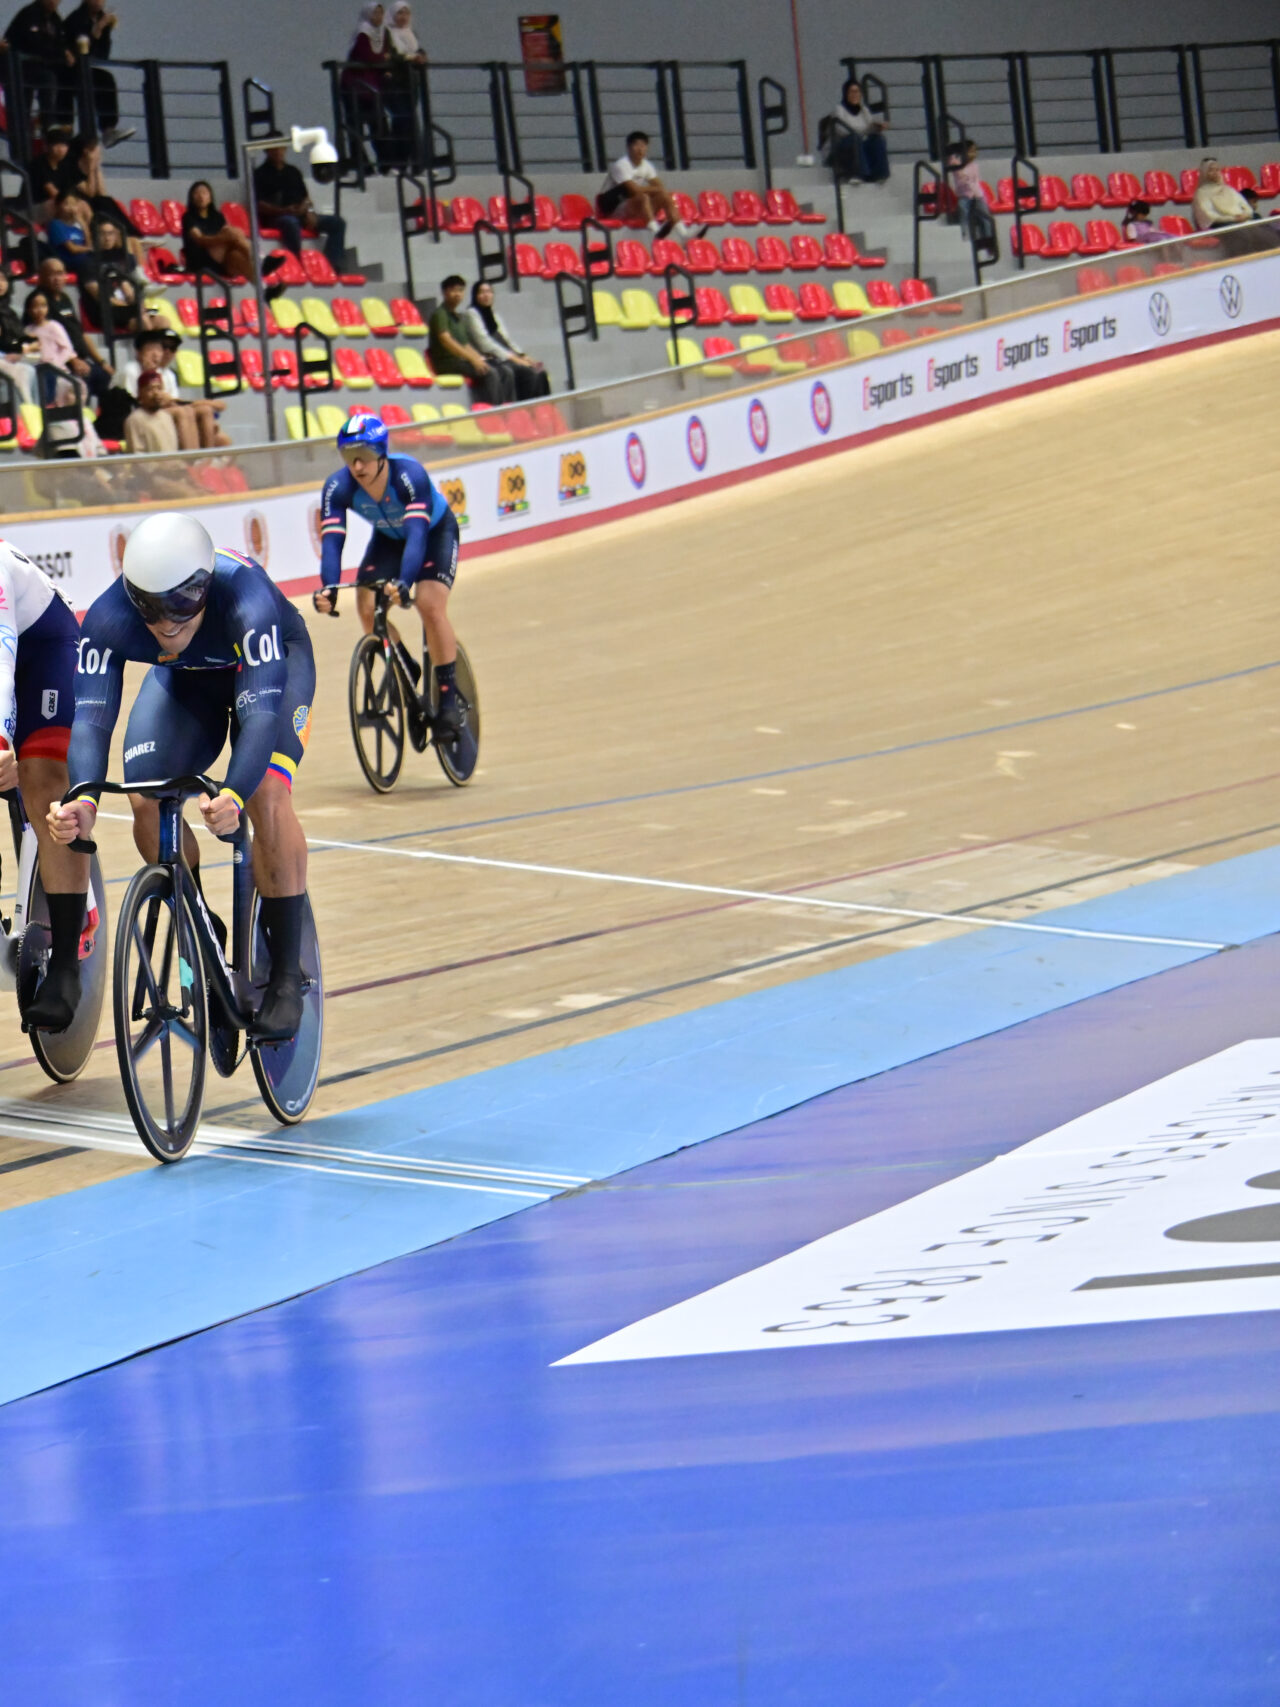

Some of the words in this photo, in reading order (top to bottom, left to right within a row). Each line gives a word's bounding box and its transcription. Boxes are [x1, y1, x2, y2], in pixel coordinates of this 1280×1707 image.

[996, 332, 1050, 371] Esports
[1063, 315, 1117, 353] Esports
[862, 372, 914, 411] Esports
[927, 353, 979, 393] Esports
[242, 624, 282, 667] Col
[124, 740, 156, 764] SUAREZ
[922, 1174, 1168, 1254] SINCE
[761, 1258, 1009, 1334] 1853
